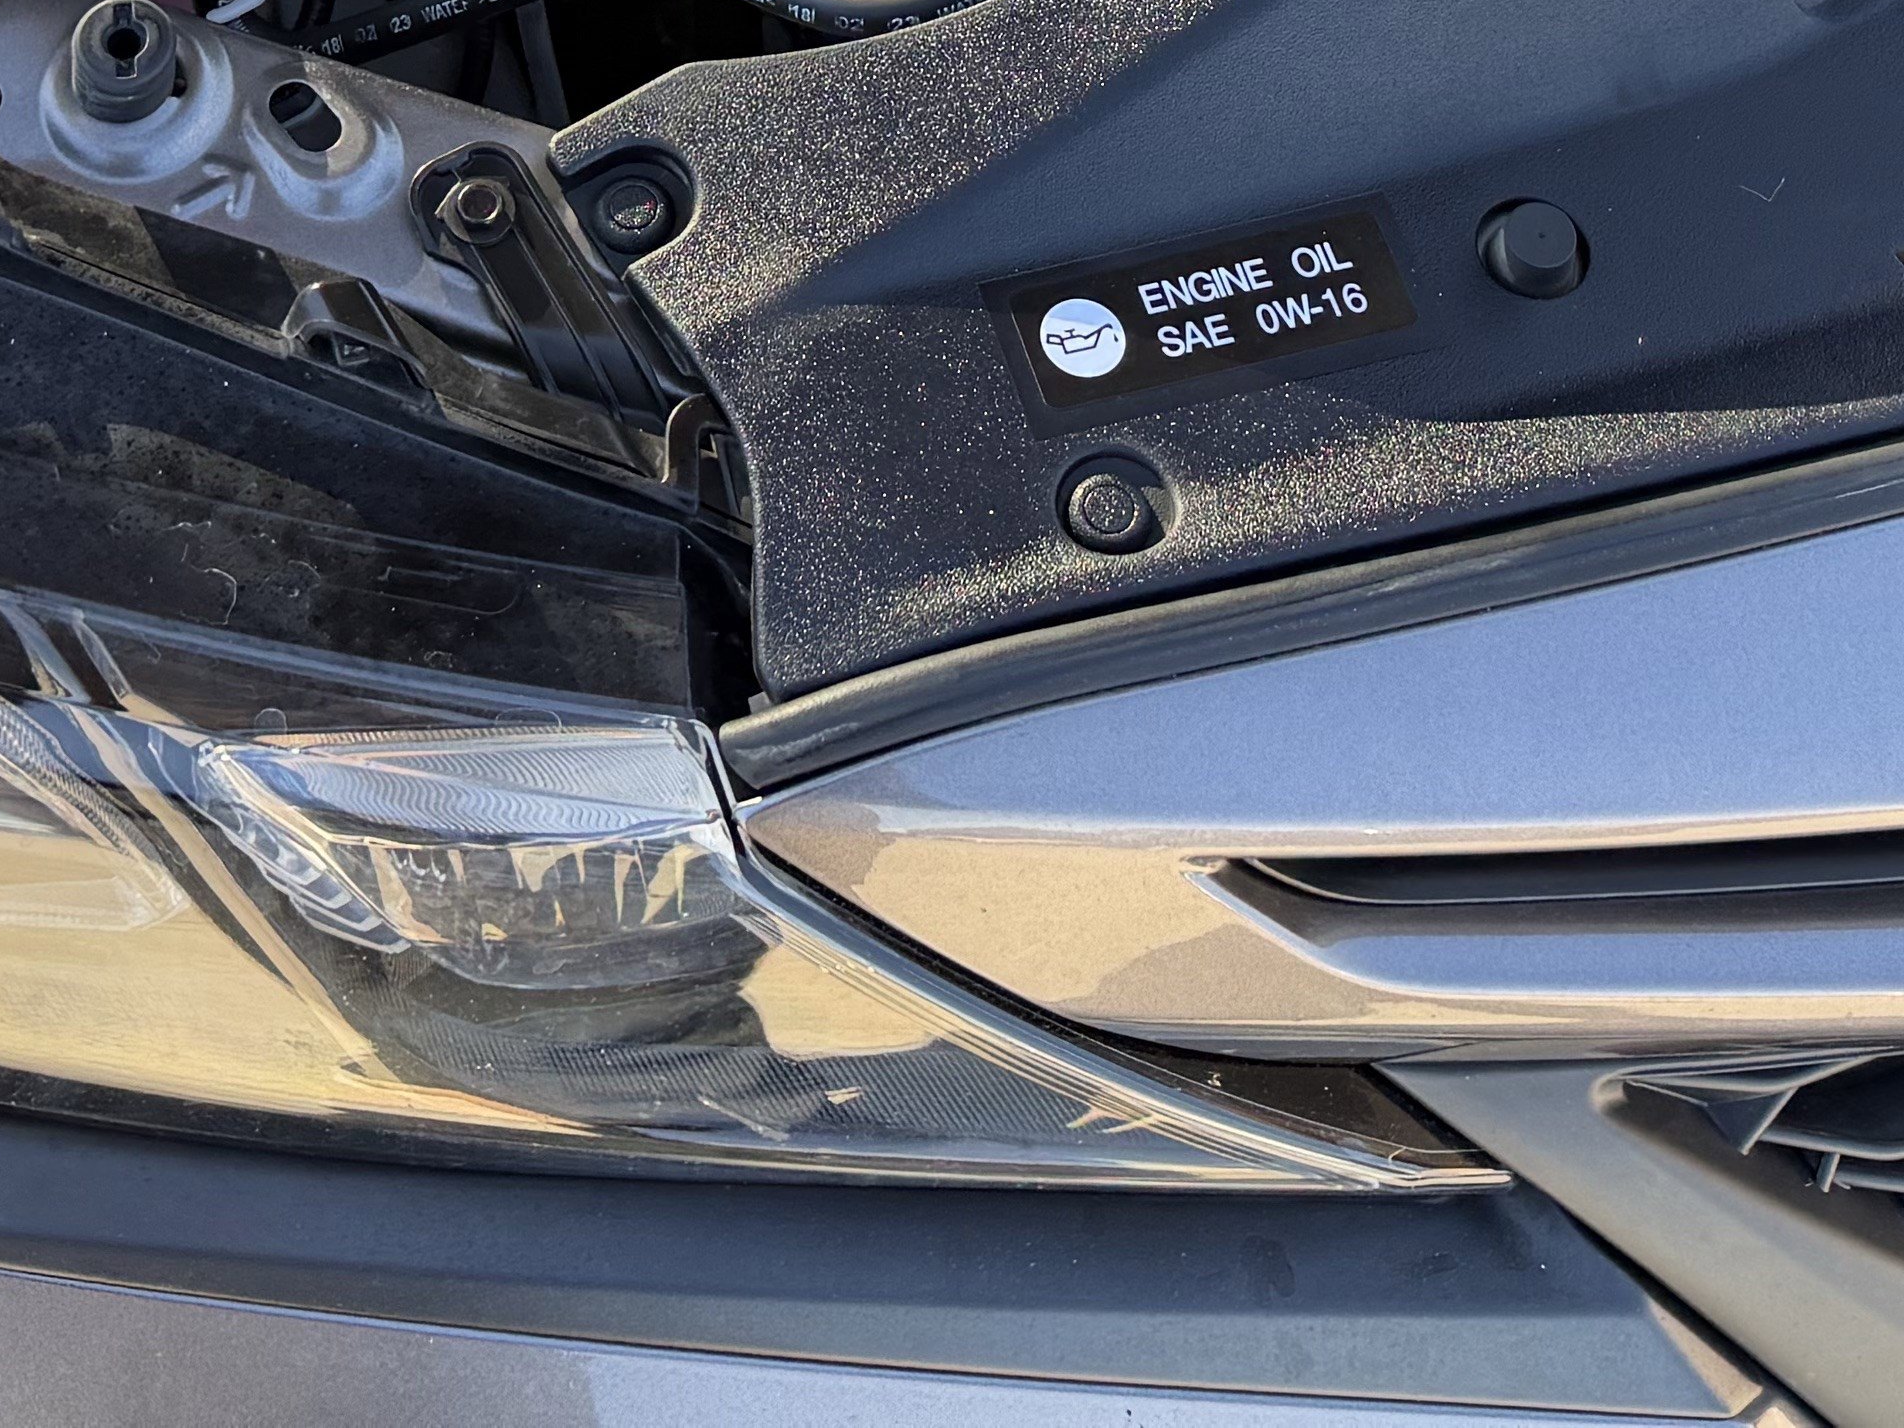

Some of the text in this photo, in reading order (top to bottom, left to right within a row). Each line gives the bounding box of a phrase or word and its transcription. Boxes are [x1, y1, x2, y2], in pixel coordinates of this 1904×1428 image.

[1137, 241, 1353, 316] ENGINE OIL
[1157, 282, 1368, 358] SAE 0W-16
